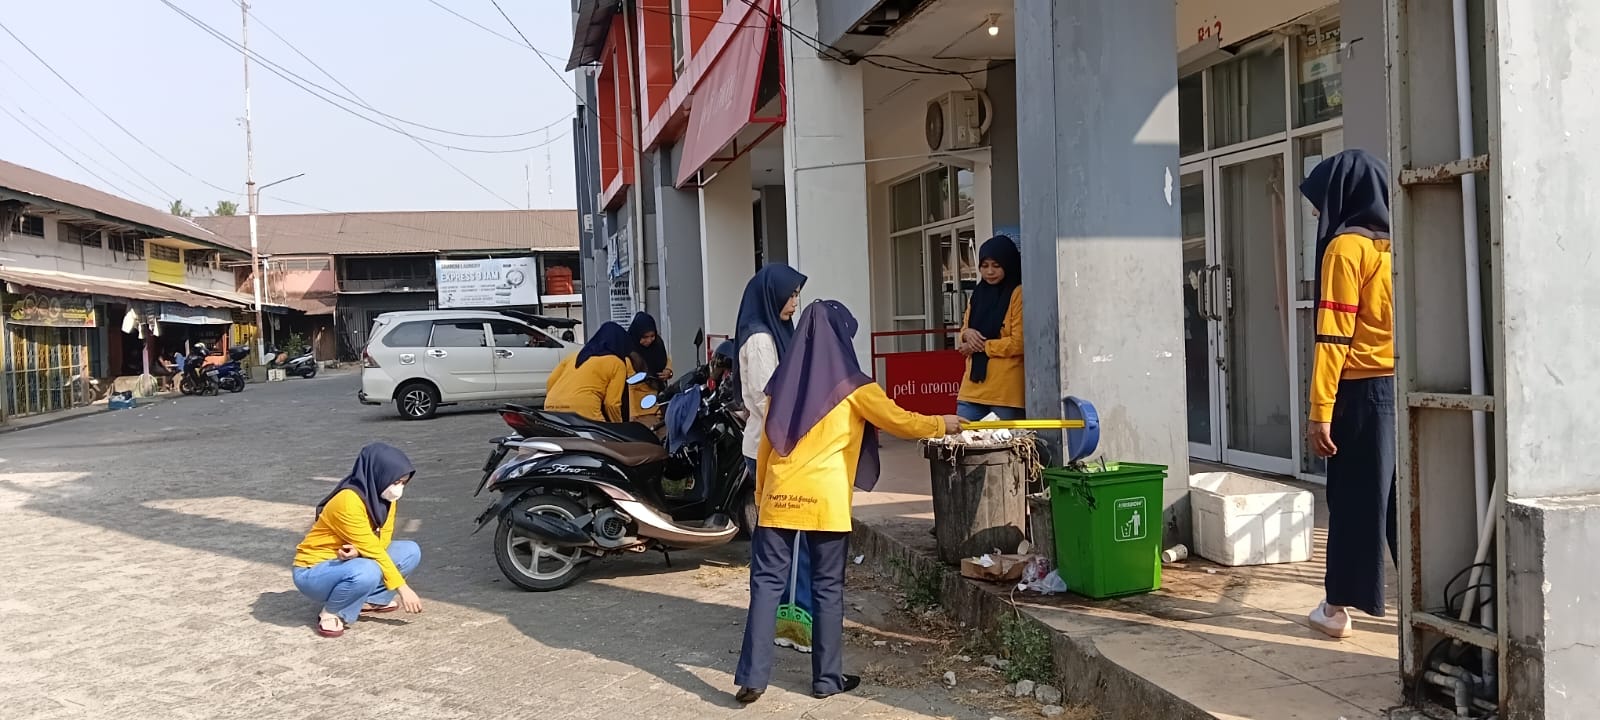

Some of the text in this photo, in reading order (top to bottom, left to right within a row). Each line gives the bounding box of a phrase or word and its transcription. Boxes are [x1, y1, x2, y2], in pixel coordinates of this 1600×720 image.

[441, 271, 475, 282] EXPRESS
[893, 380, 960, 400] peti aroma
